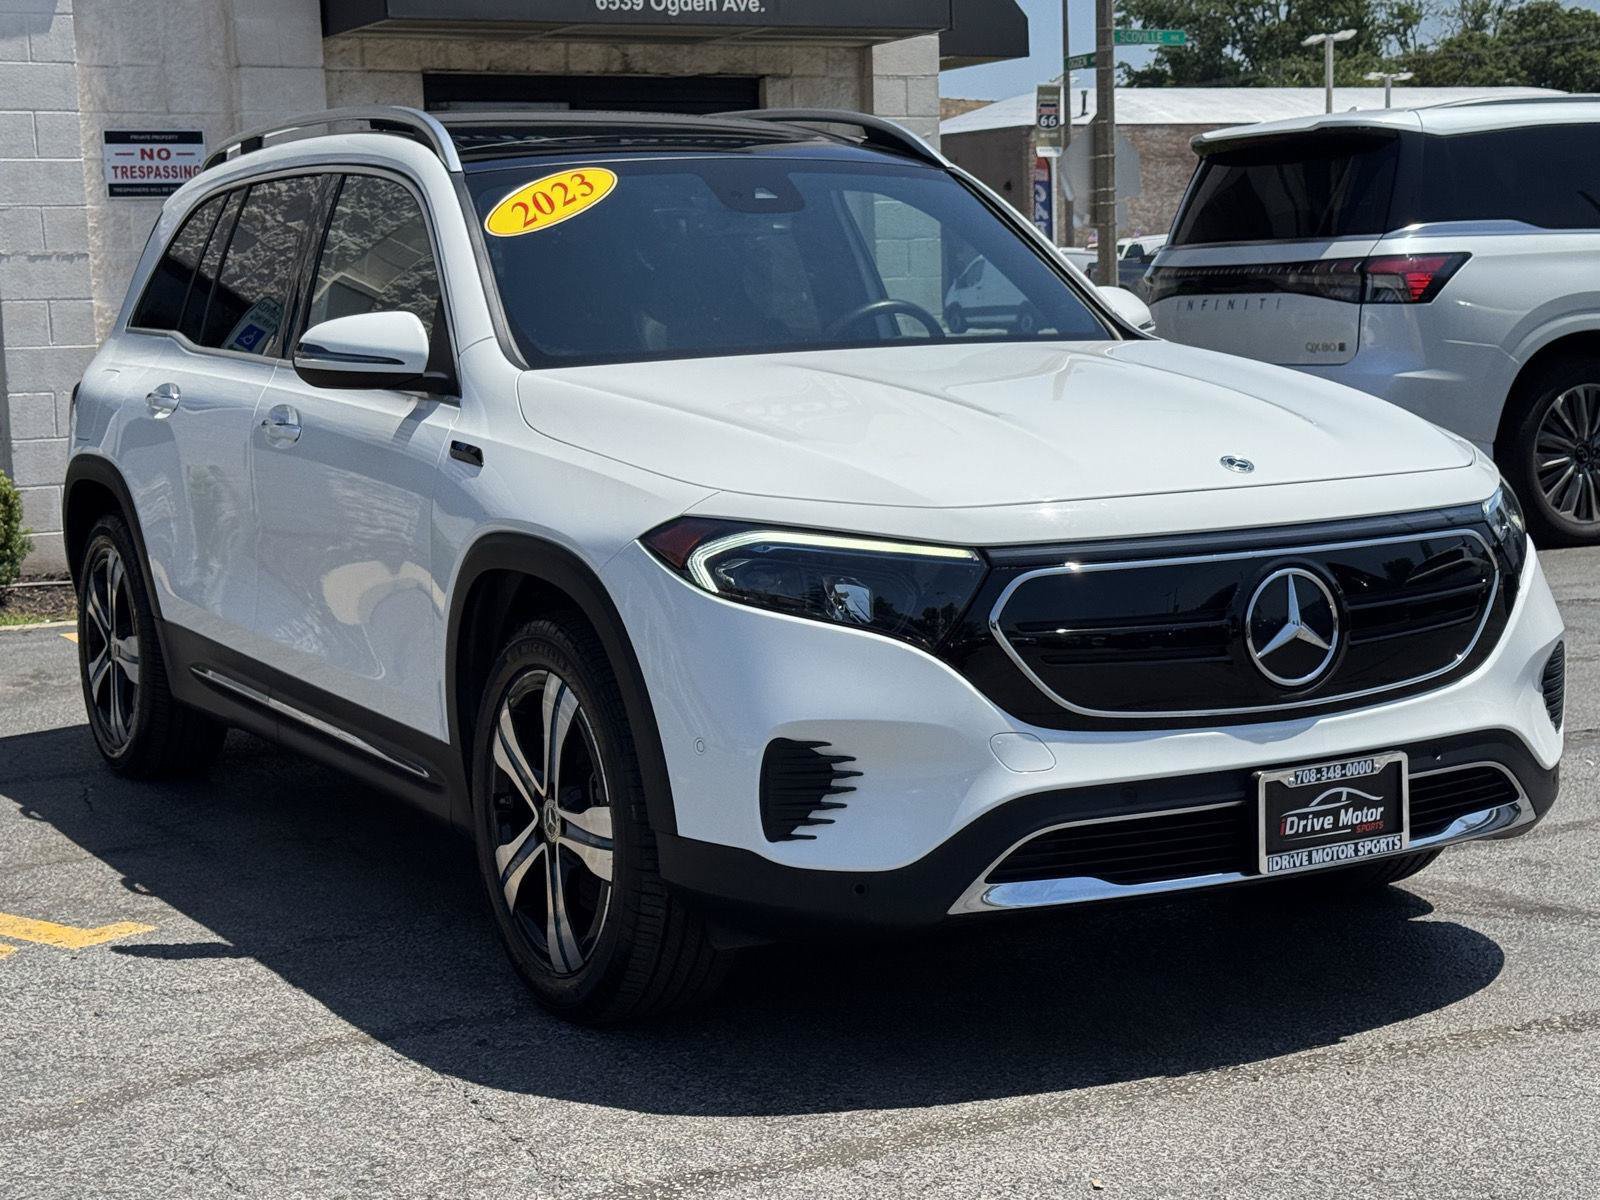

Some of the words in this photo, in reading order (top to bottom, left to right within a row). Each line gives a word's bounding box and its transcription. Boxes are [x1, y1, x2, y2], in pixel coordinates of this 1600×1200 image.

[650, 0, 717, 16] Ogden
[722, 0, 766, 12] Ave.
[1120, 31, 1163, 43] SCOVILLE
[1040, 115, 1057, 127] 66
[139, 148, 171, 161] NO
[112, 165, 201, 180] TRESPASSING
[511, 173, 594, 228] 2023
[1176, 297, 1281, 312] INFINITI
[1305, 341, 1337, 354] QX80
[1295, 760, 1373, 784] 708-348-0000
[1279, 813, 1334, 837] iDrive
[1339, 806, 1385, 828] Motor
[1355, 821, 1385, 834] SPORTS
[1311, 844, 1355, 864] MOTOR
[1357, 835, 1401, 856] SPORTS
